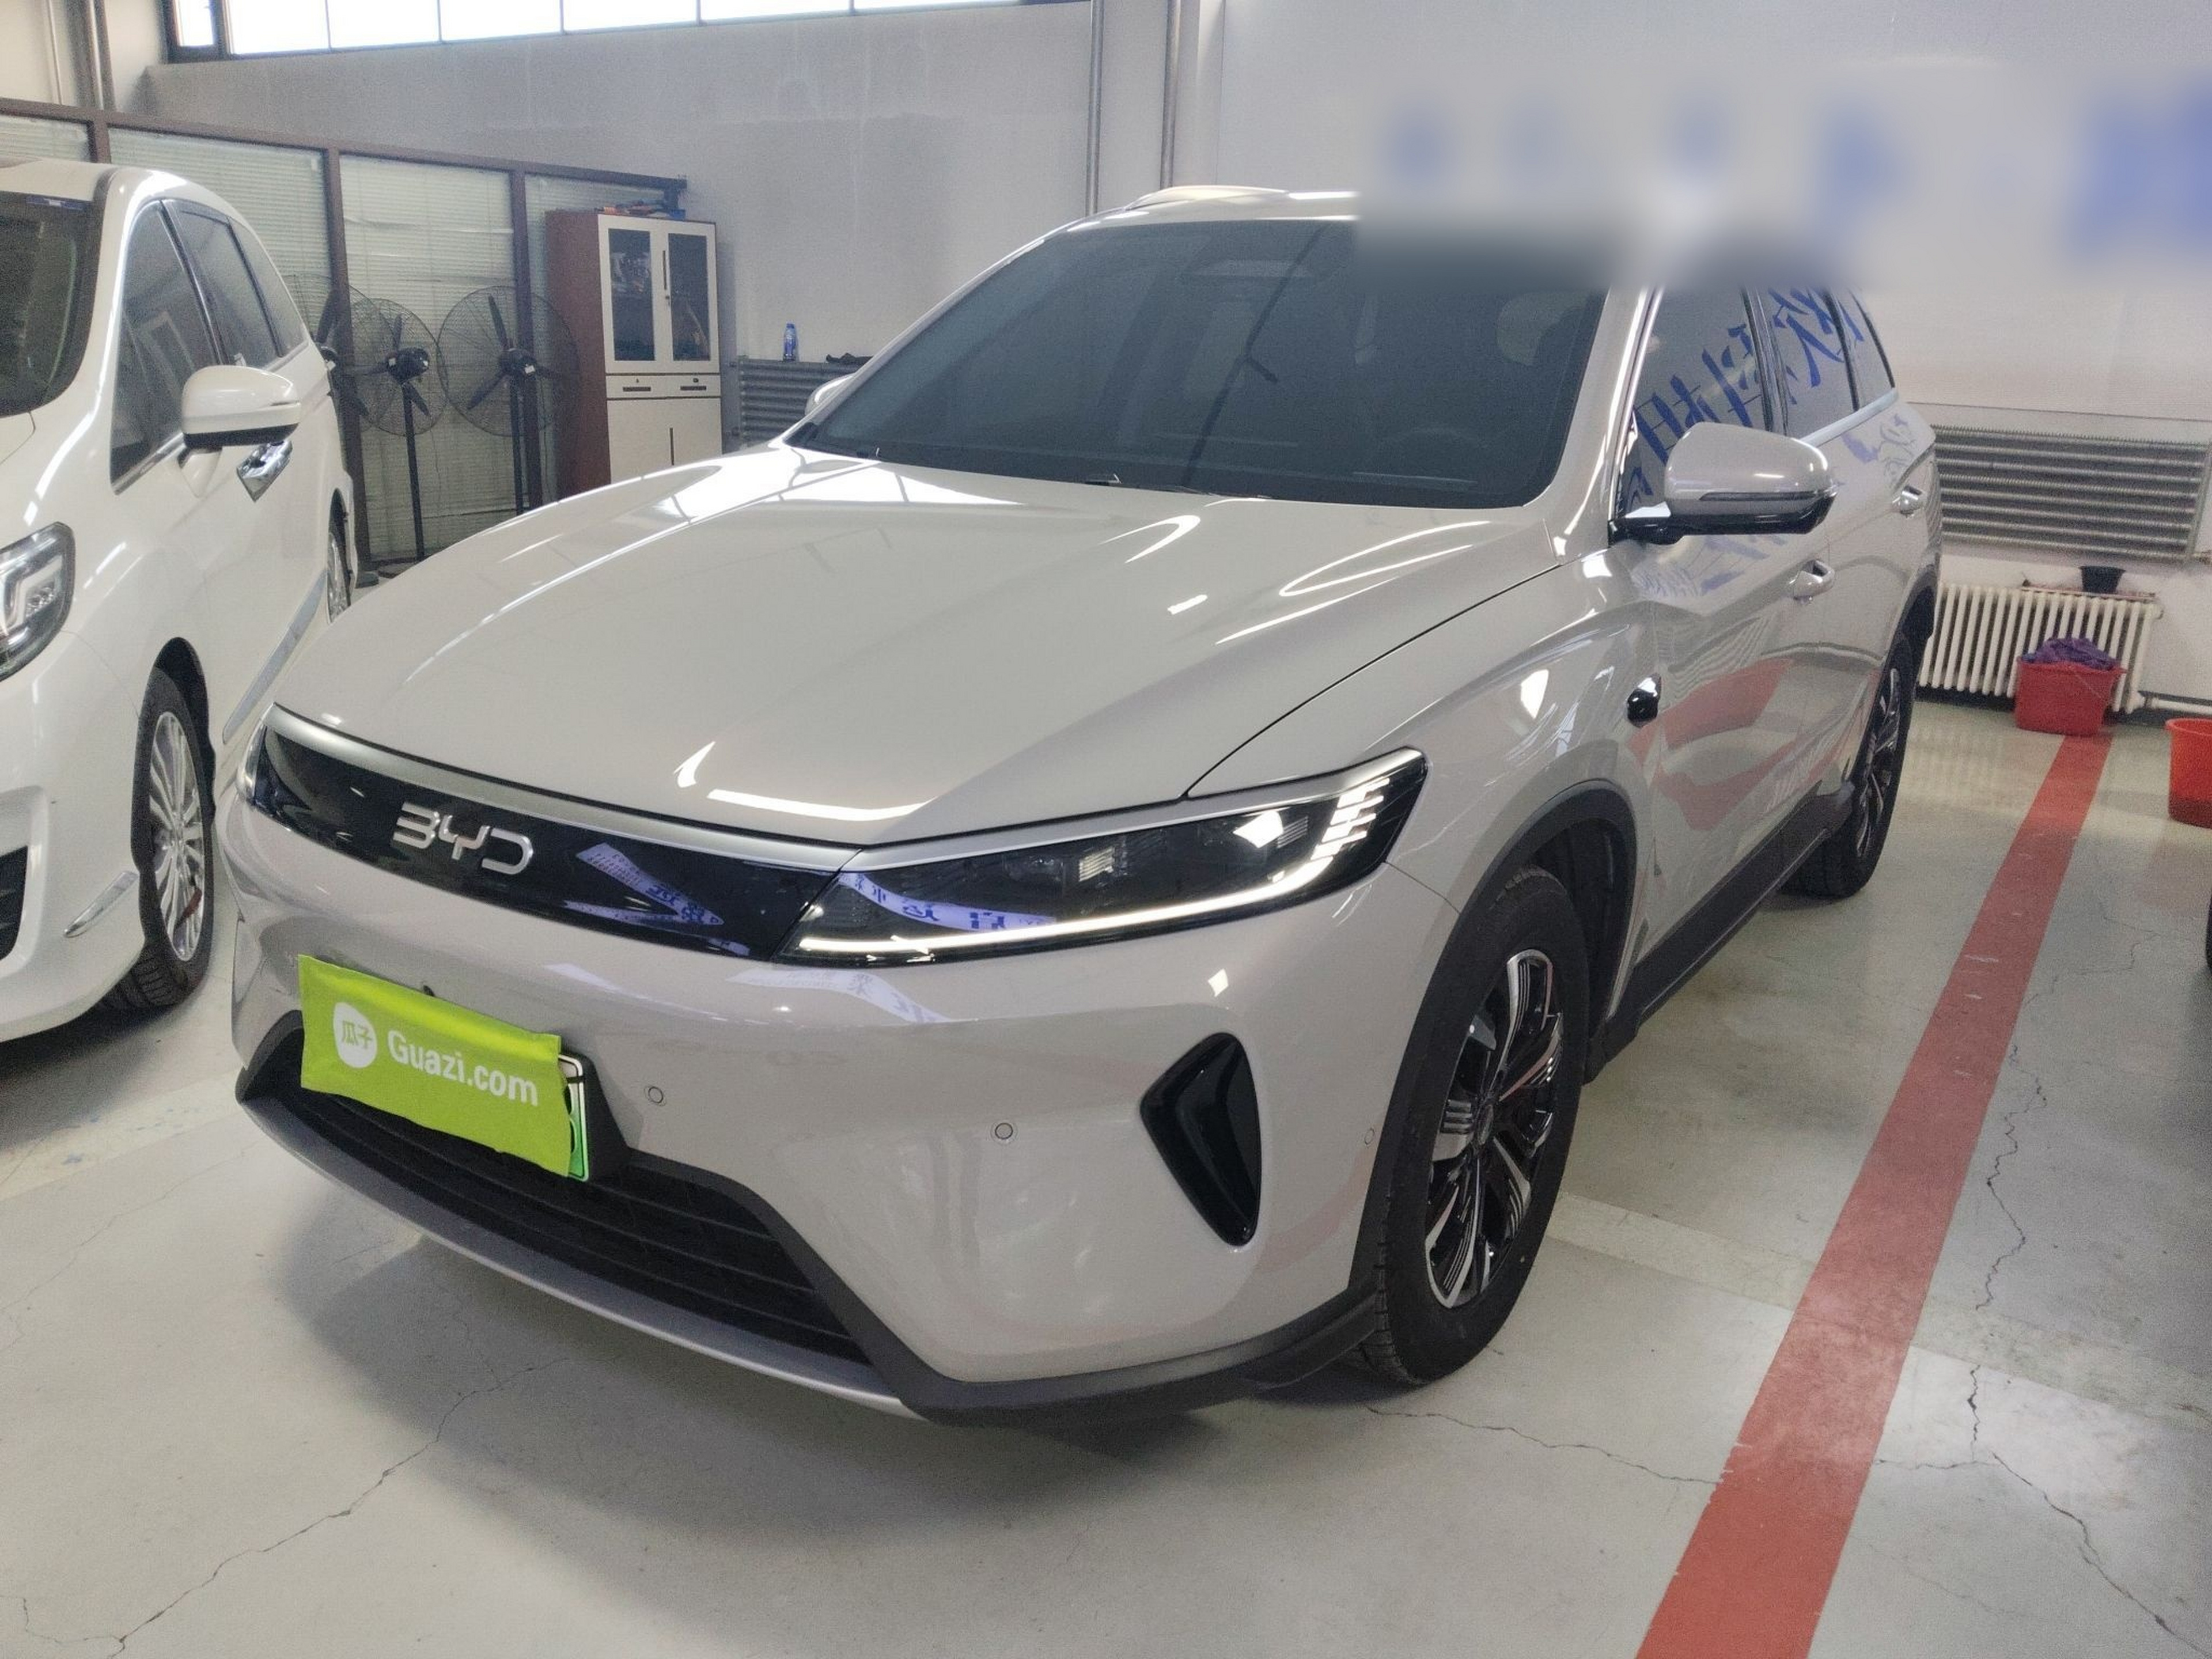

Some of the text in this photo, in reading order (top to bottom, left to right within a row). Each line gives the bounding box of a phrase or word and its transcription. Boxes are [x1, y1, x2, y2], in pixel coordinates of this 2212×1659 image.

[393, 801, 533, 874] BYD
[342, 1019, 372, 1049] 瓜子
[387, 1029, 539, 1107] Guazi.com
